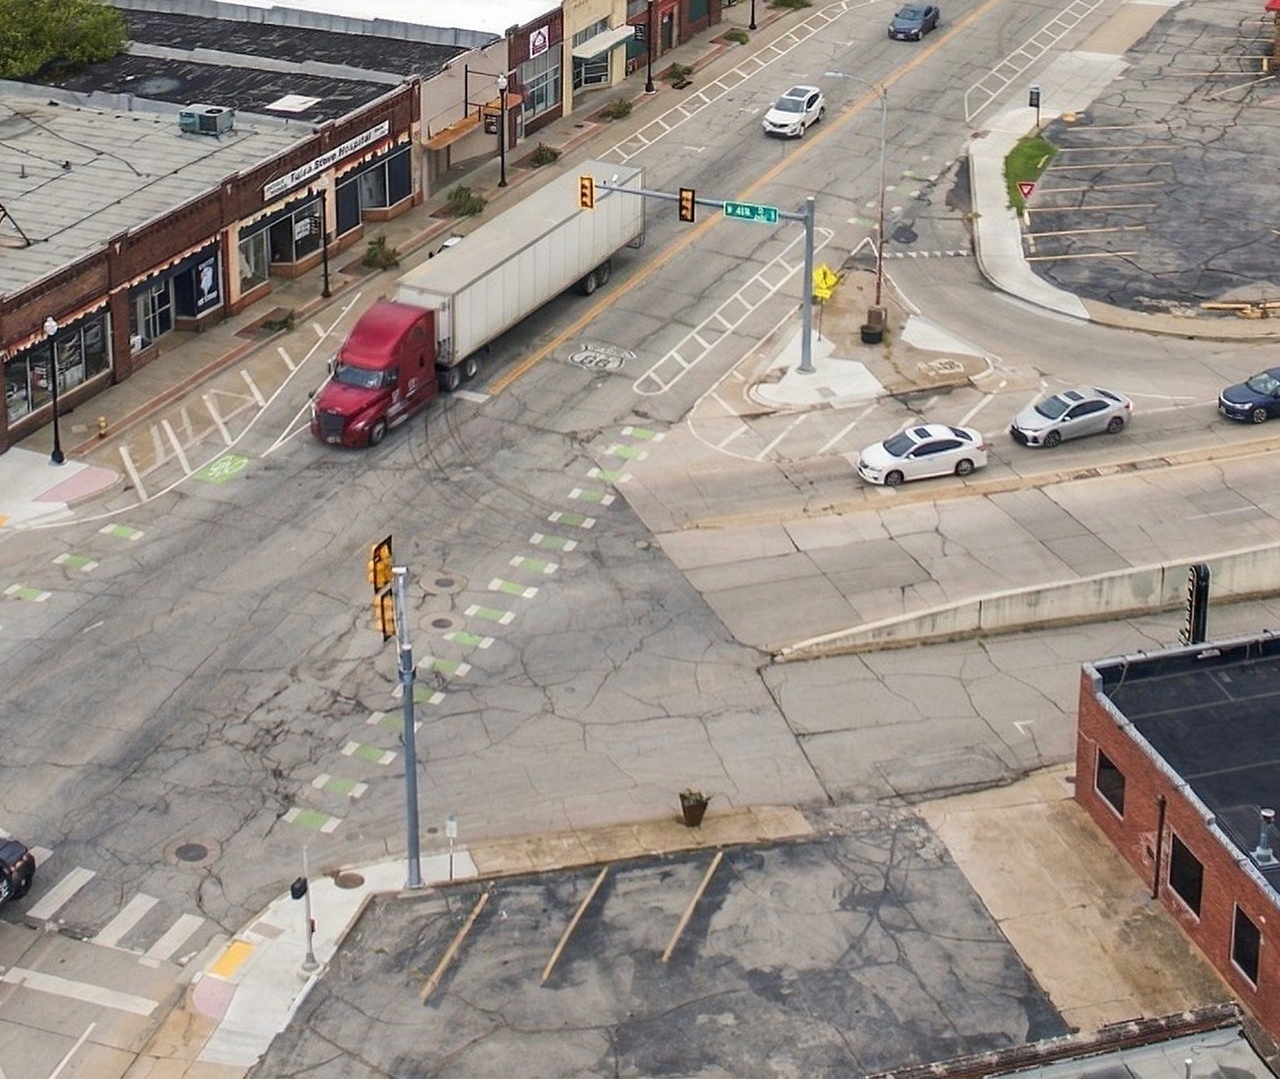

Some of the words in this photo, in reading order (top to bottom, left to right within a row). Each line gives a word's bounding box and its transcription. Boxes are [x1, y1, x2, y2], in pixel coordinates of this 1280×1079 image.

[290, 165, 312, 183] Tulsa
[314, 152, 337, 170] Stove
[338, 132, 372, 156] Hospital
